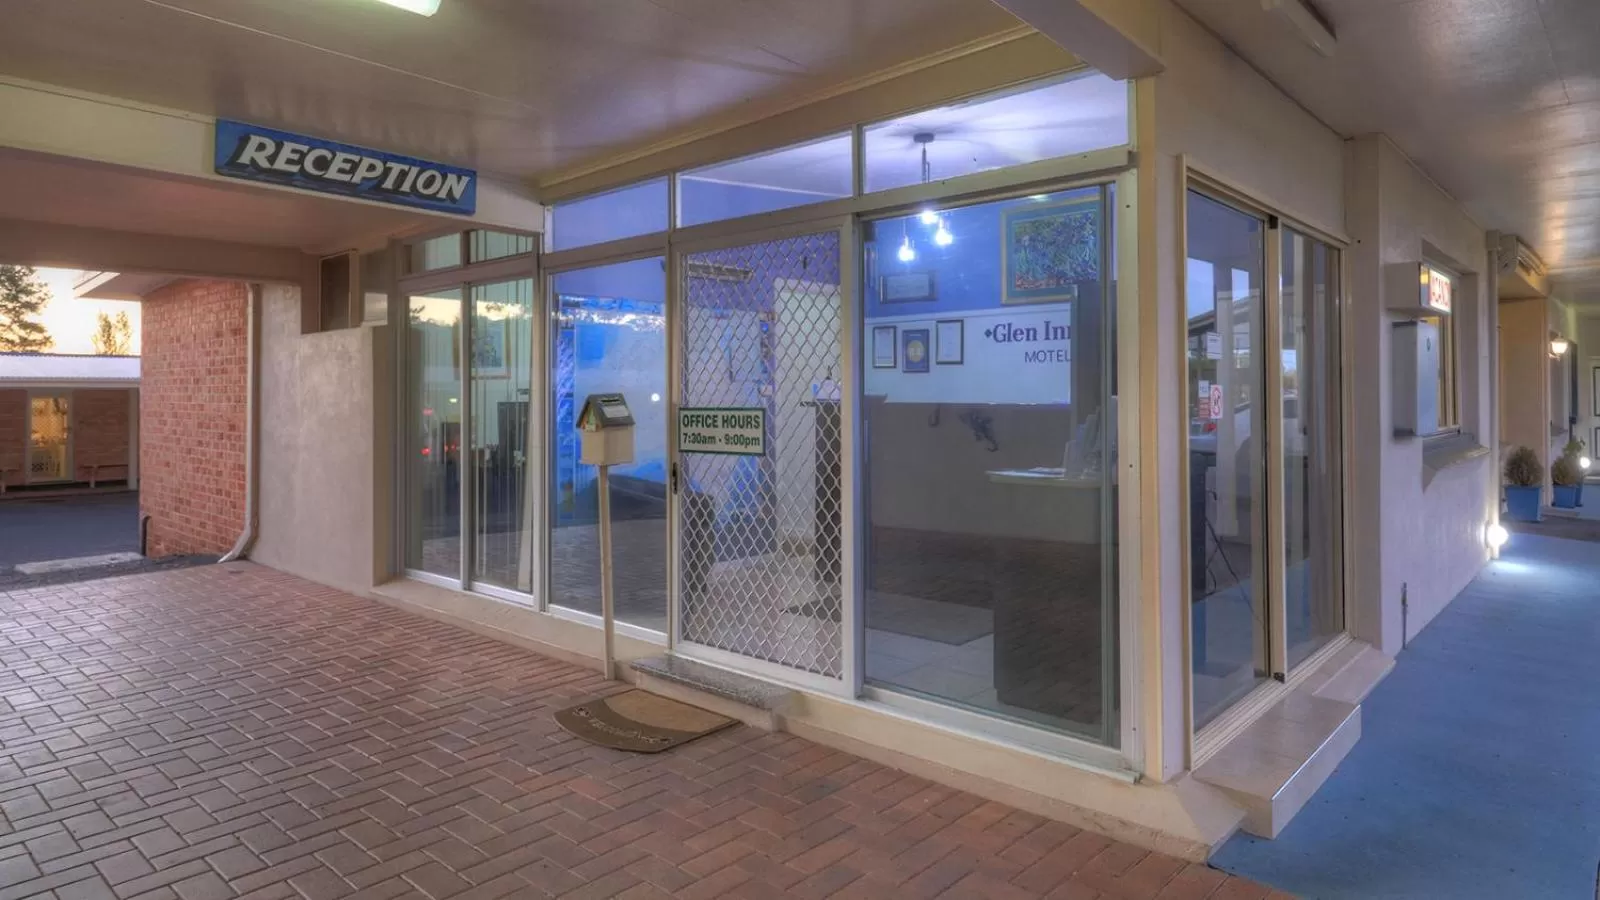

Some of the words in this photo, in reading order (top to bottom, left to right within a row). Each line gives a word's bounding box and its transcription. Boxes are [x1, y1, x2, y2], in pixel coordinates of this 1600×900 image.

[235, 134, 471, 201] RECEPTION
[993, 322, 1038, 343] Glen
[1024, 349, 1072, 363] MOTEL
[682, 414, 719, 428] OFFICE
[722, 415, 761, 429] HOURS
[683, 432, 716, 445] 7:30am
[724, 434, 760, 448] 9:00pm
